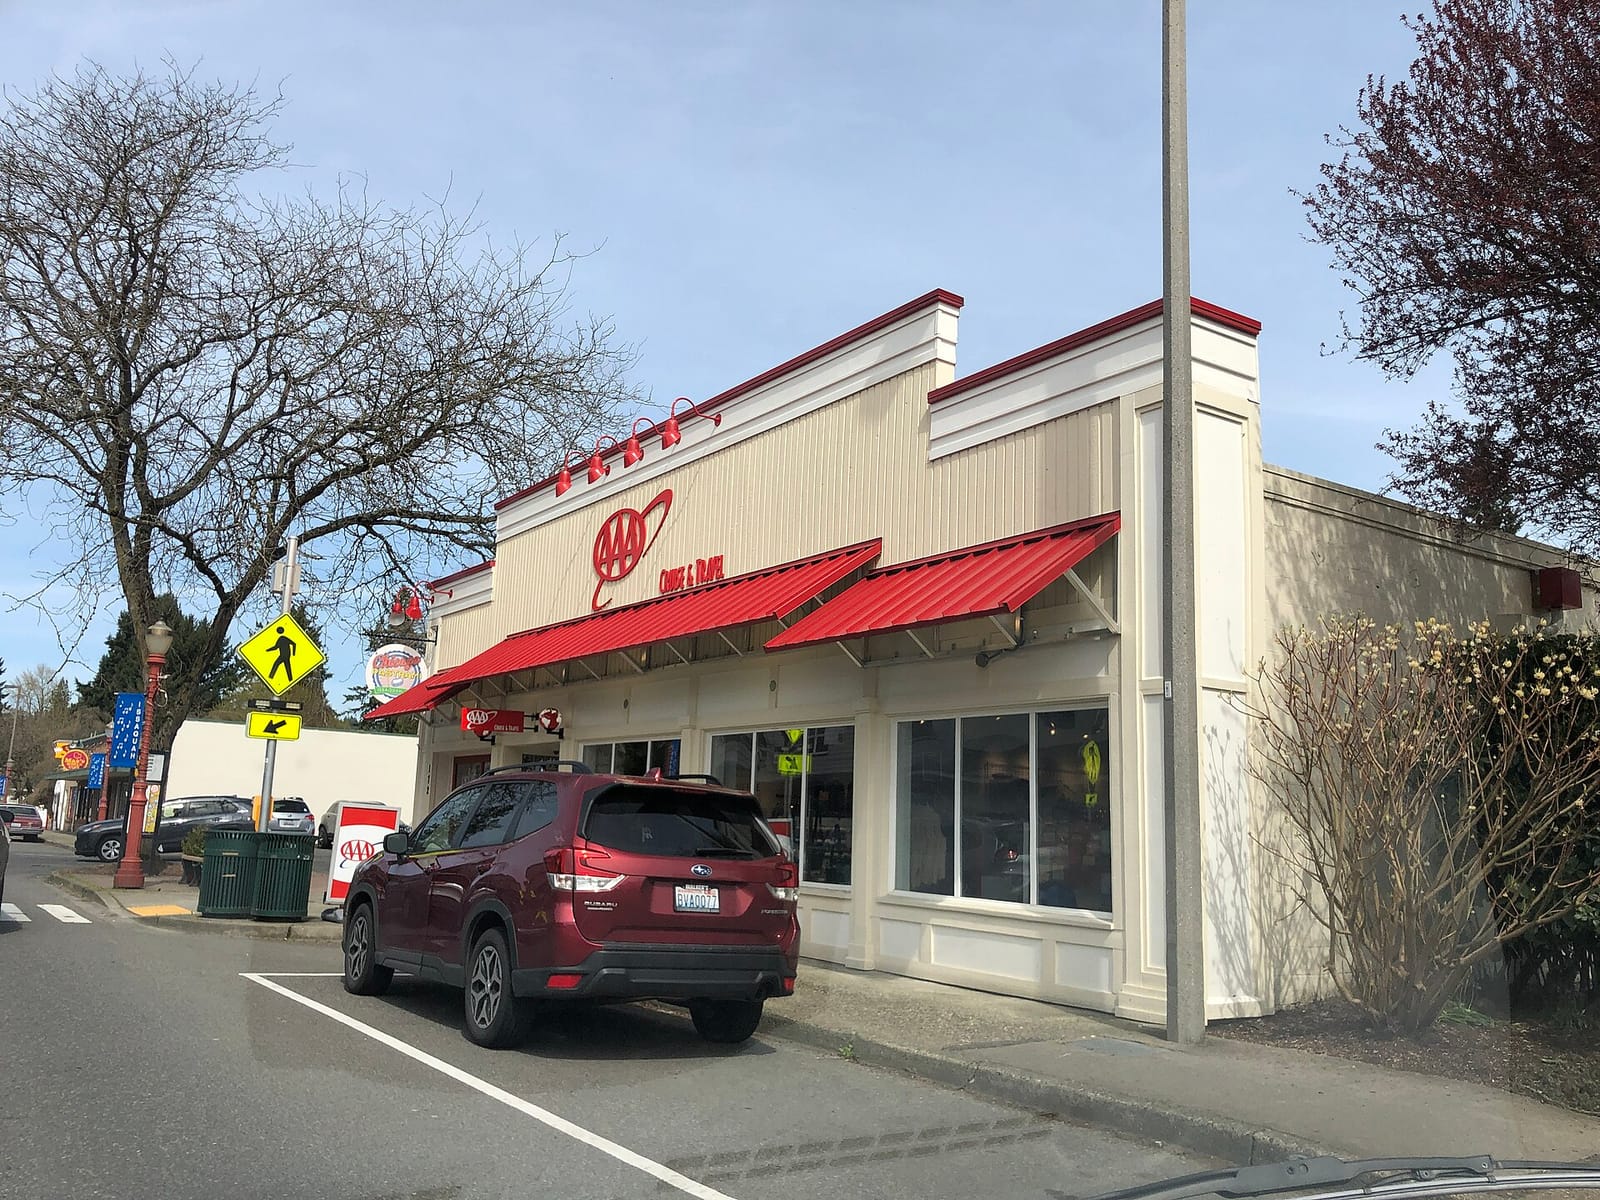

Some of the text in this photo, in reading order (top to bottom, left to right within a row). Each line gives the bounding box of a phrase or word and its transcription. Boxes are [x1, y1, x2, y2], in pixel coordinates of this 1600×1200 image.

[597, 510, 643, 580] AAA
[468, 711, 487, 724] AAA
[130, 701, 142, 760] ISSAQUAH
[343, 841, 373, 861] AAA
[678, 894, 717, 908] BVA0077
